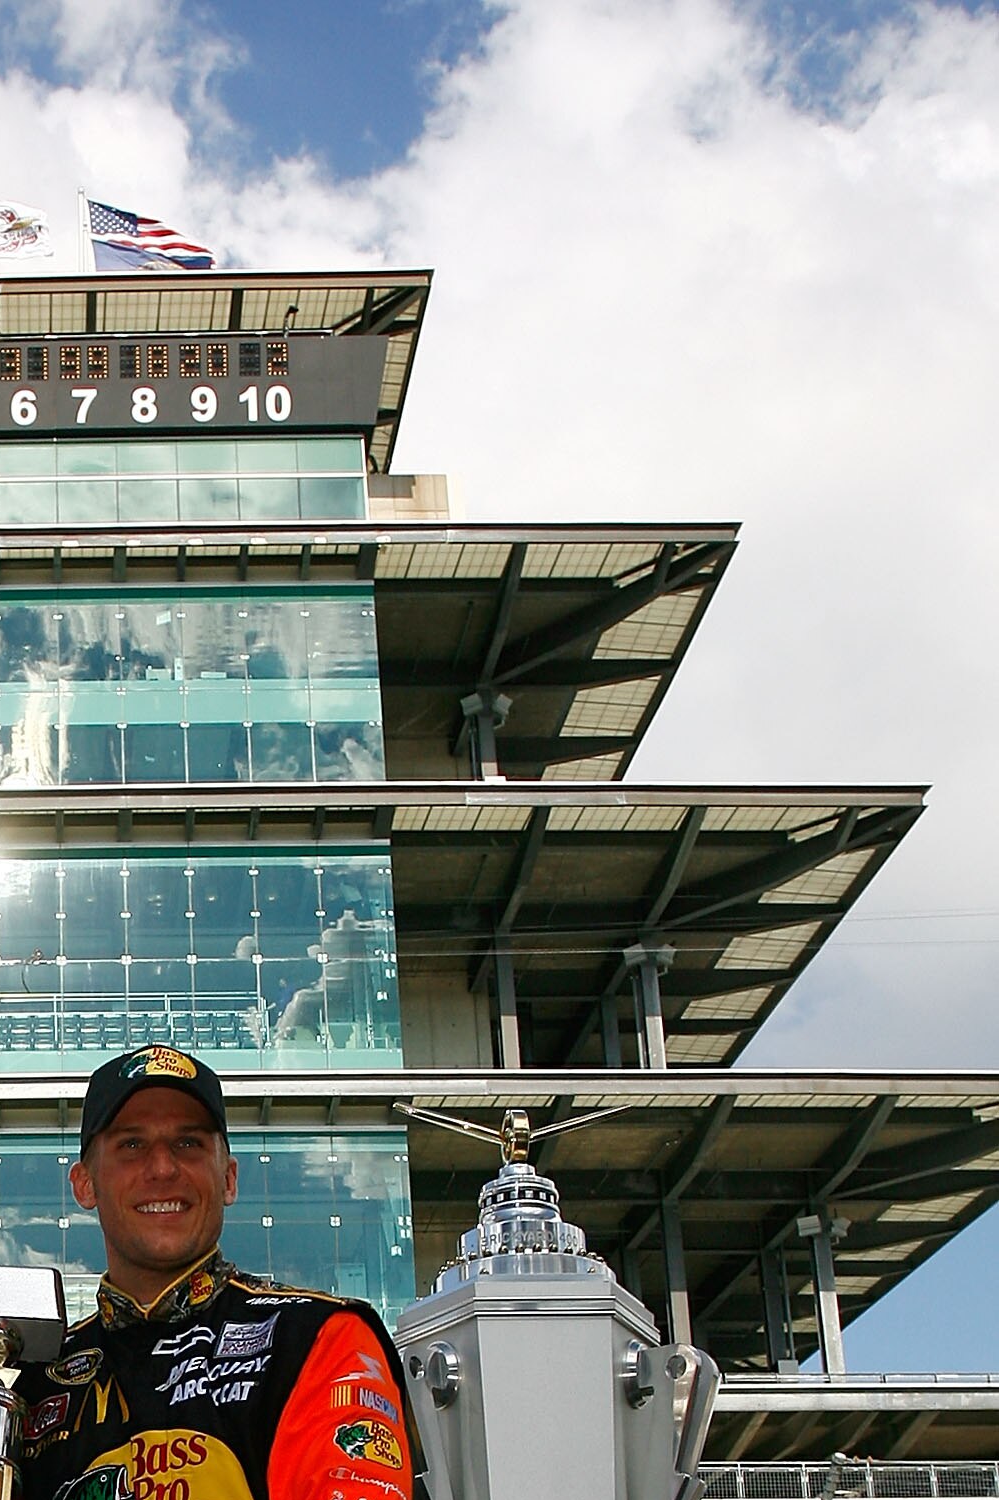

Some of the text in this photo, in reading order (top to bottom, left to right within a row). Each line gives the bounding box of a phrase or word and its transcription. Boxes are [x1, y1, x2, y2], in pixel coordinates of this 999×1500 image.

[0, 347, 49, 381] 31
[60, 345, 109, 380] 99
[134, 345, 169, 378] 18
[179, 343, 228, 378] 20
[266, 342, 289, 377] 2
[10, 388, 38, 426] 6
[70, 387, 99, 424] 7
[130, 386, 158, 424] 8
[190, 385, 218, 423] 9
[238, 384, 293, 422] 10
[359, 1387, 399, 1425] NASCAR
[130, 1434, 209, 1480] Bass
